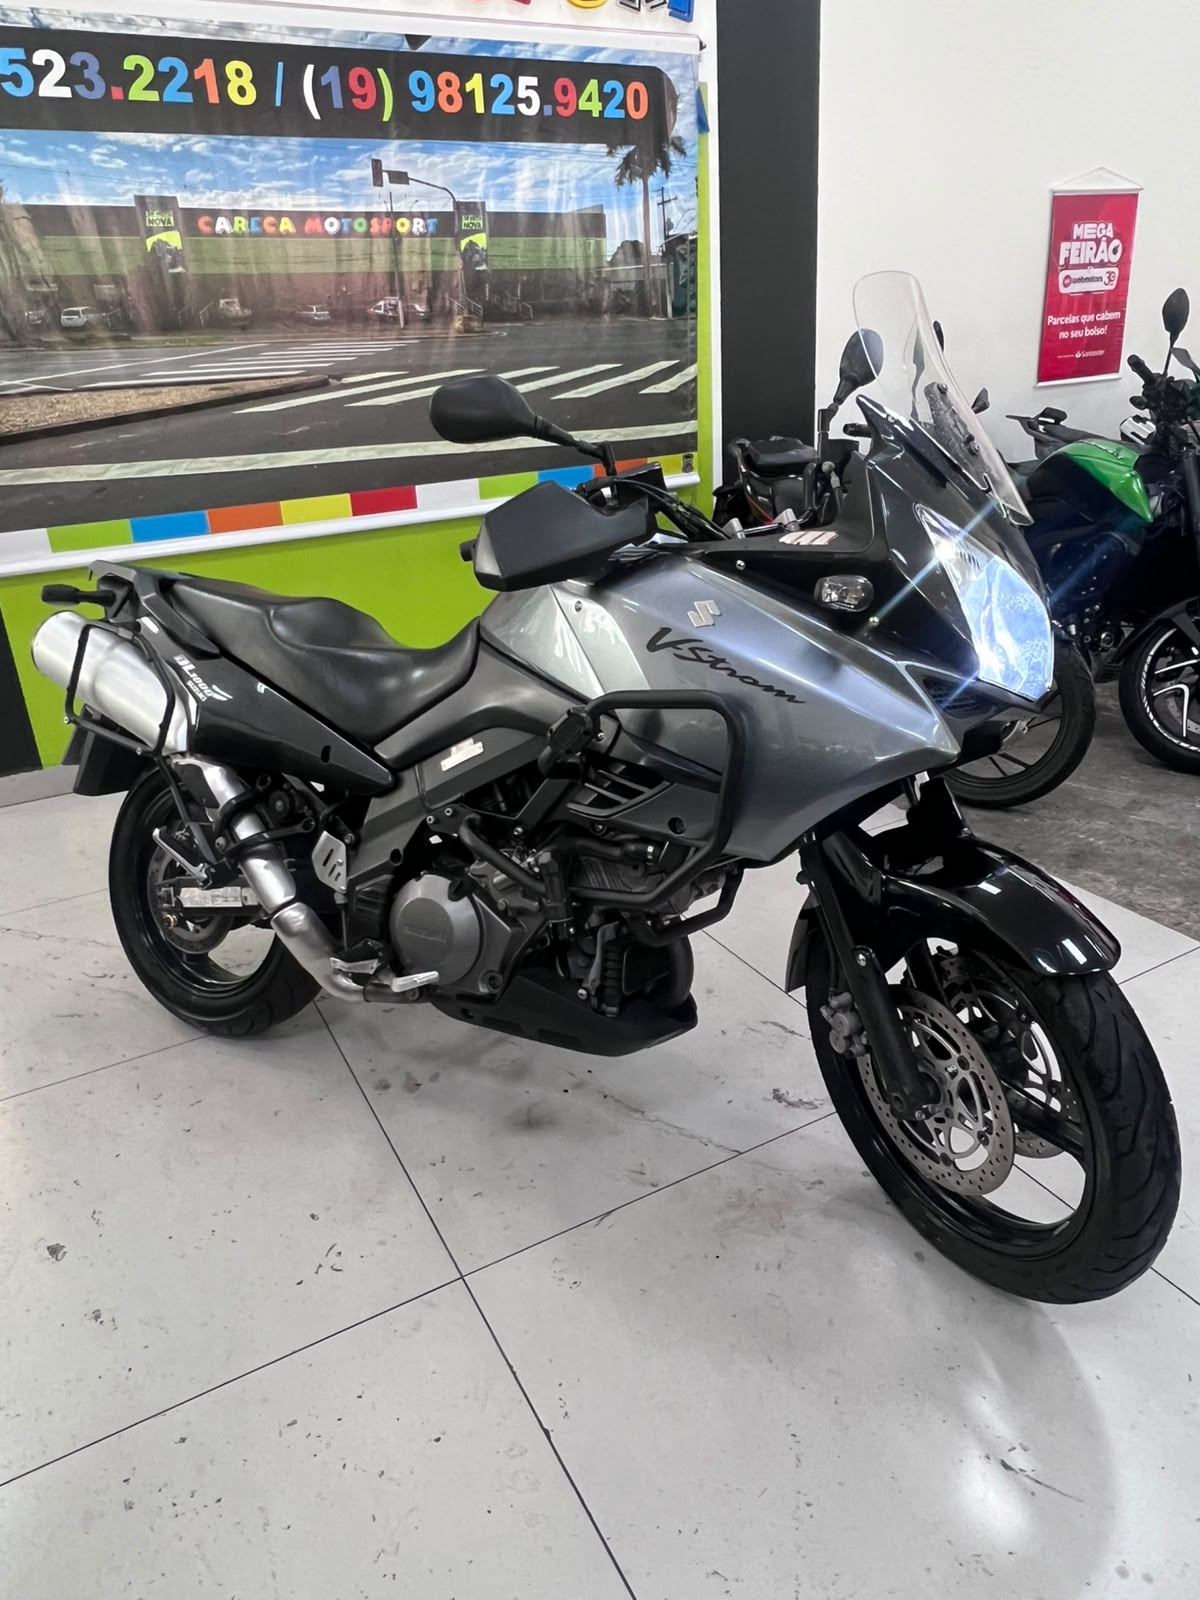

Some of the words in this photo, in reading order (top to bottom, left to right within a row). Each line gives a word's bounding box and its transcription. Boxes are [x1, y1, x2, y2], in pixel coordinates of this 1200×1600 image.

[303, 64, 393, 121] (19)
[408, 70, 649, 120] 98125.9420
[197, 215, 296, 235] CARECA
[304, 216, 440, 235] MOTOSPORT
[1072, 222, 1114, 240] MEGA
[1059, 237, 1123, 266] FEIRÃO
[1047, 313, 1080, 326] Parcelas
[1080, 313, 1095, 325] que
[1095, 310, 1121, 321] cabem
[1058, 331, 1070, 340] no
[1070, 328, 1084, 338] seu
[1084, 324, 1108, 337] bolso!
